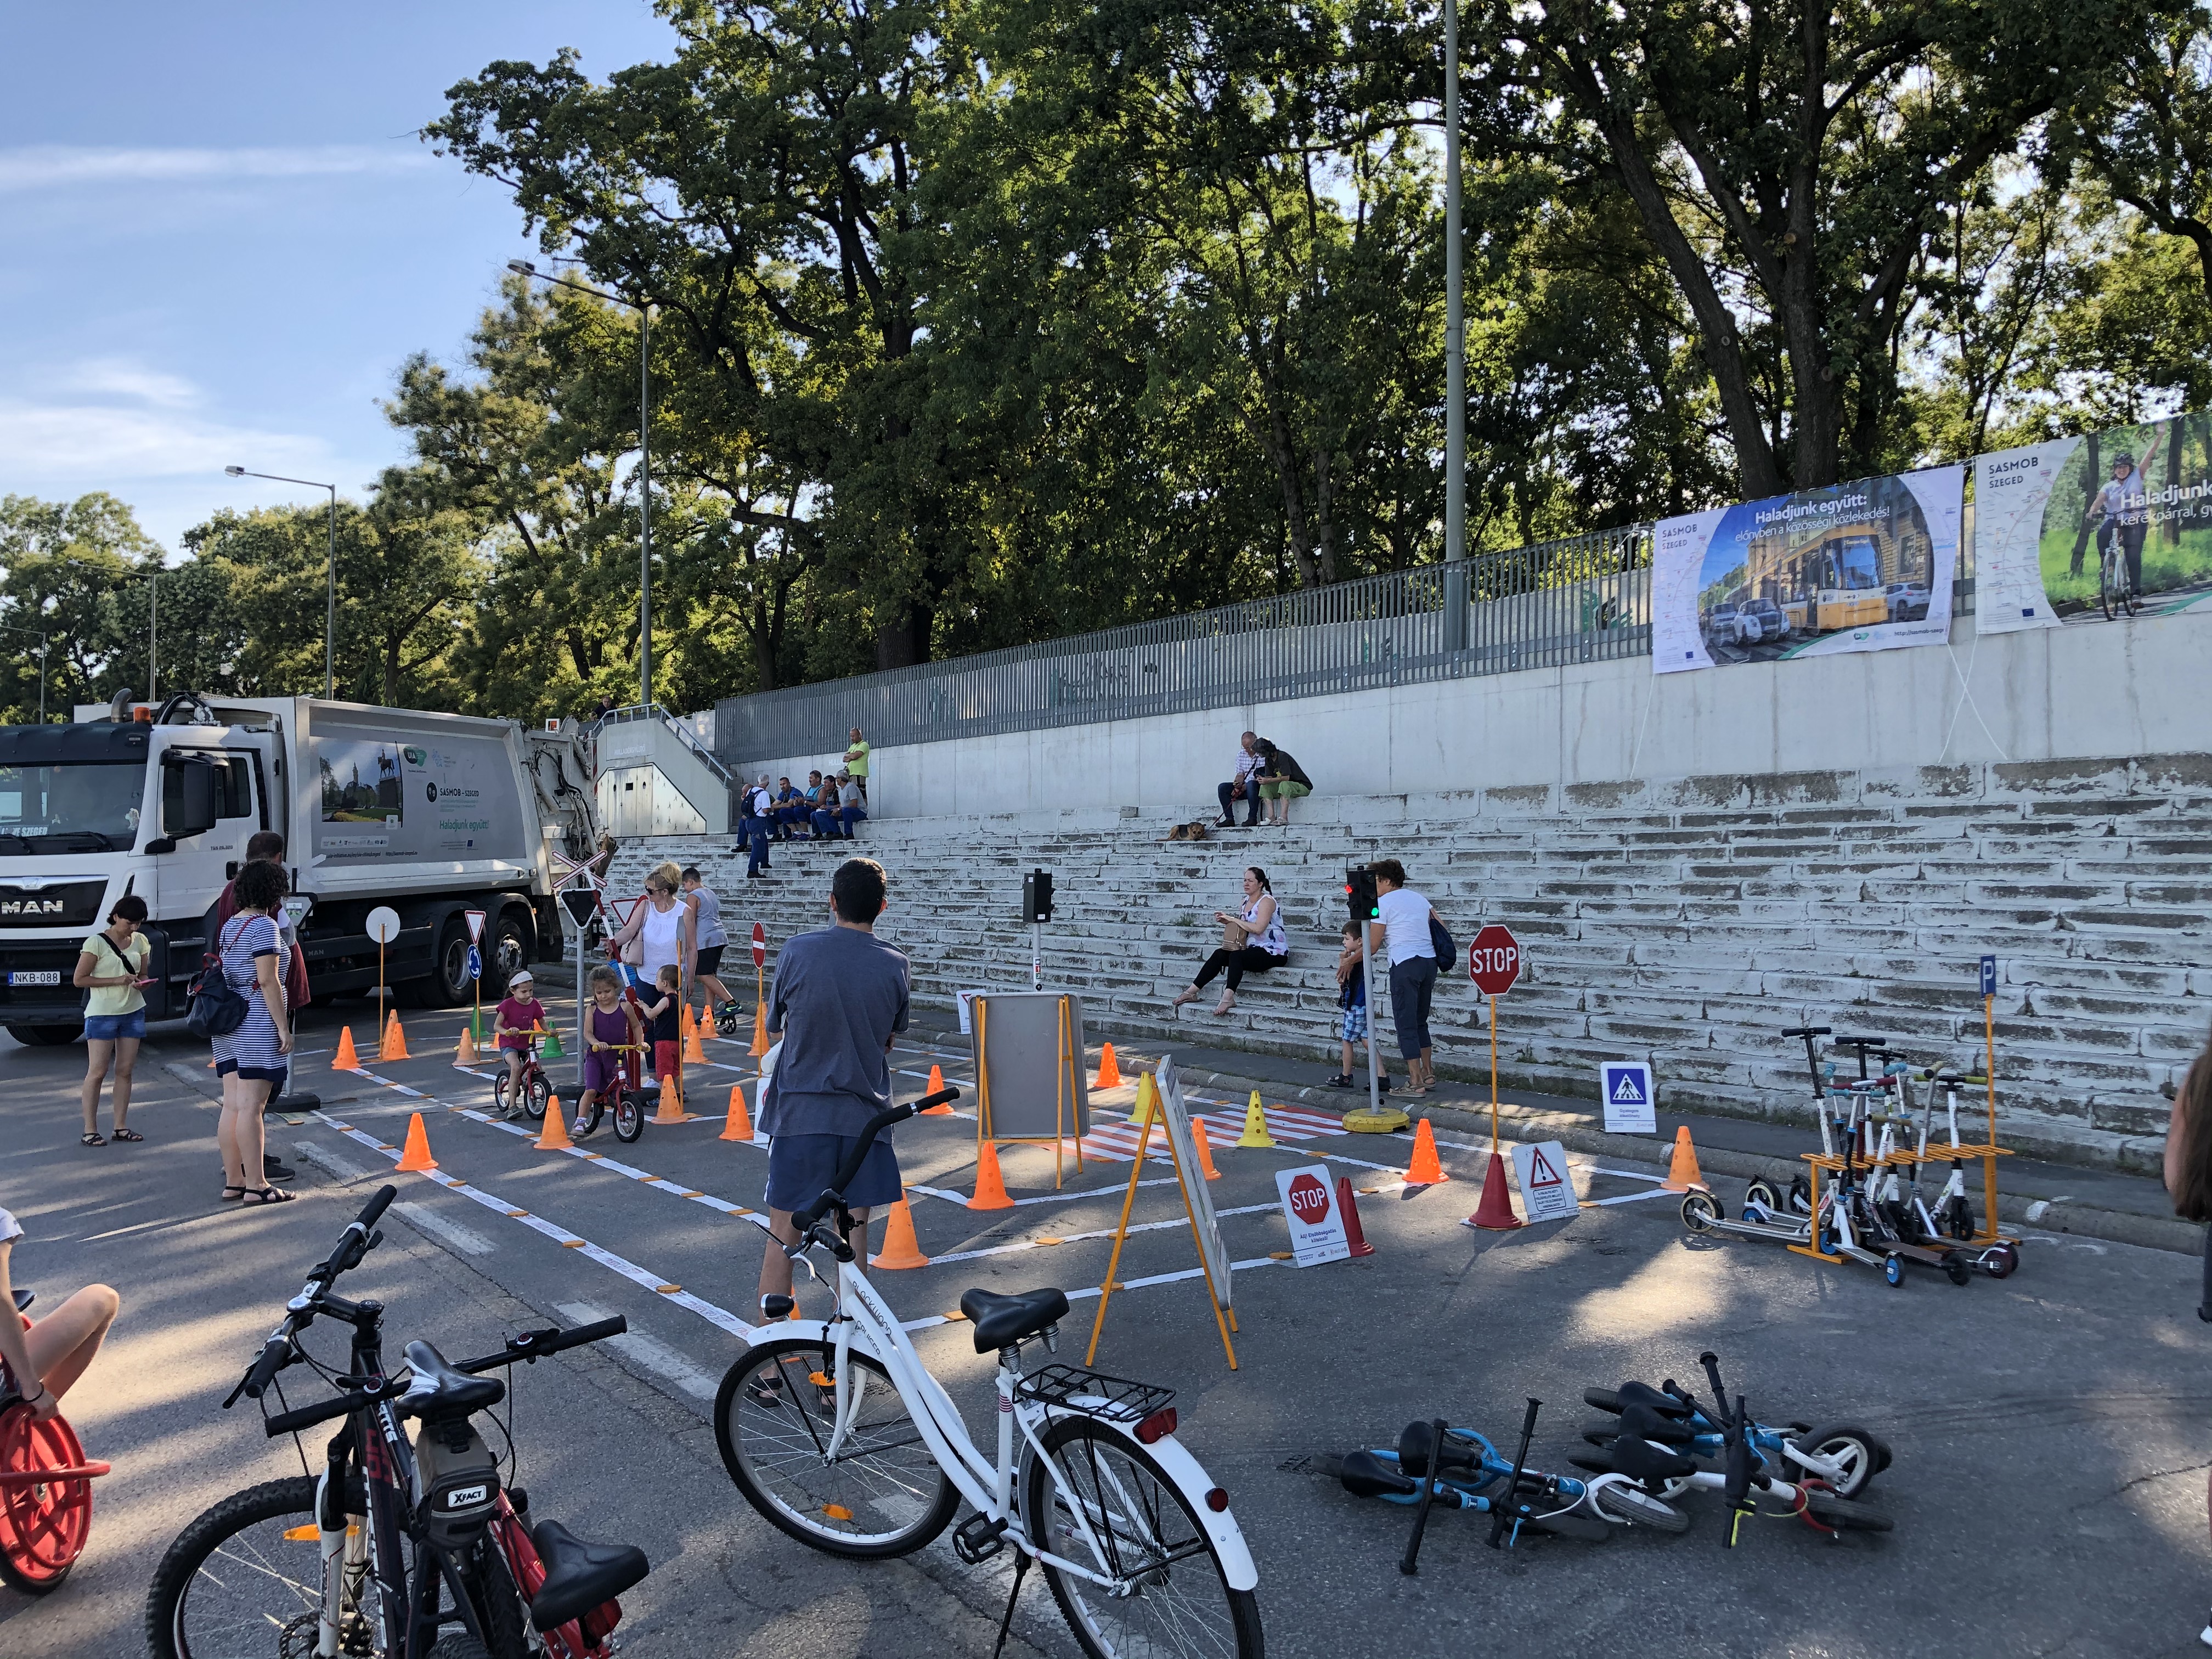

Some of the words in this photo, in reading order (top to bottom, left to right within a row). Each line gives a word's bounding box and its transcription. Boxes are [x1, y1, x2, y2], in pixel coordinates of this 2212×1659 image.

[1989, 456, 2039, 475] SASMOB
[1989, 475, 2024, 489] SZEGED
[2120, 478, 2212, 509] Haladjunk
[1755, 502, 1818, 524] Haladjunk
[1819, 494, 1868, 515] együtt:
[1662, 523, 1698, 538] SASMOB
[1735, 527, 1777, 543] előnyben
[1832, 506, 1891, 526] közlekedés!
[1662, 539, 1688, 550] SZEGED
[440, 788, 461, 797] SASMOB
[21, 826, 48, 837] SZEGED
[439, 819, 468, 832] Haladjunk
[469, 819, 489, 832] együtt!
[2, 900, 64, 915] MAN
[1472, 947, 1517, 974] STOP
[15, 973, 58, 983] NKB-088
[1983, 960, 1994, 994] P
[1291, 1187, 1325, 1211] STOP
[453, 1490, 483, 1504] XFACT
